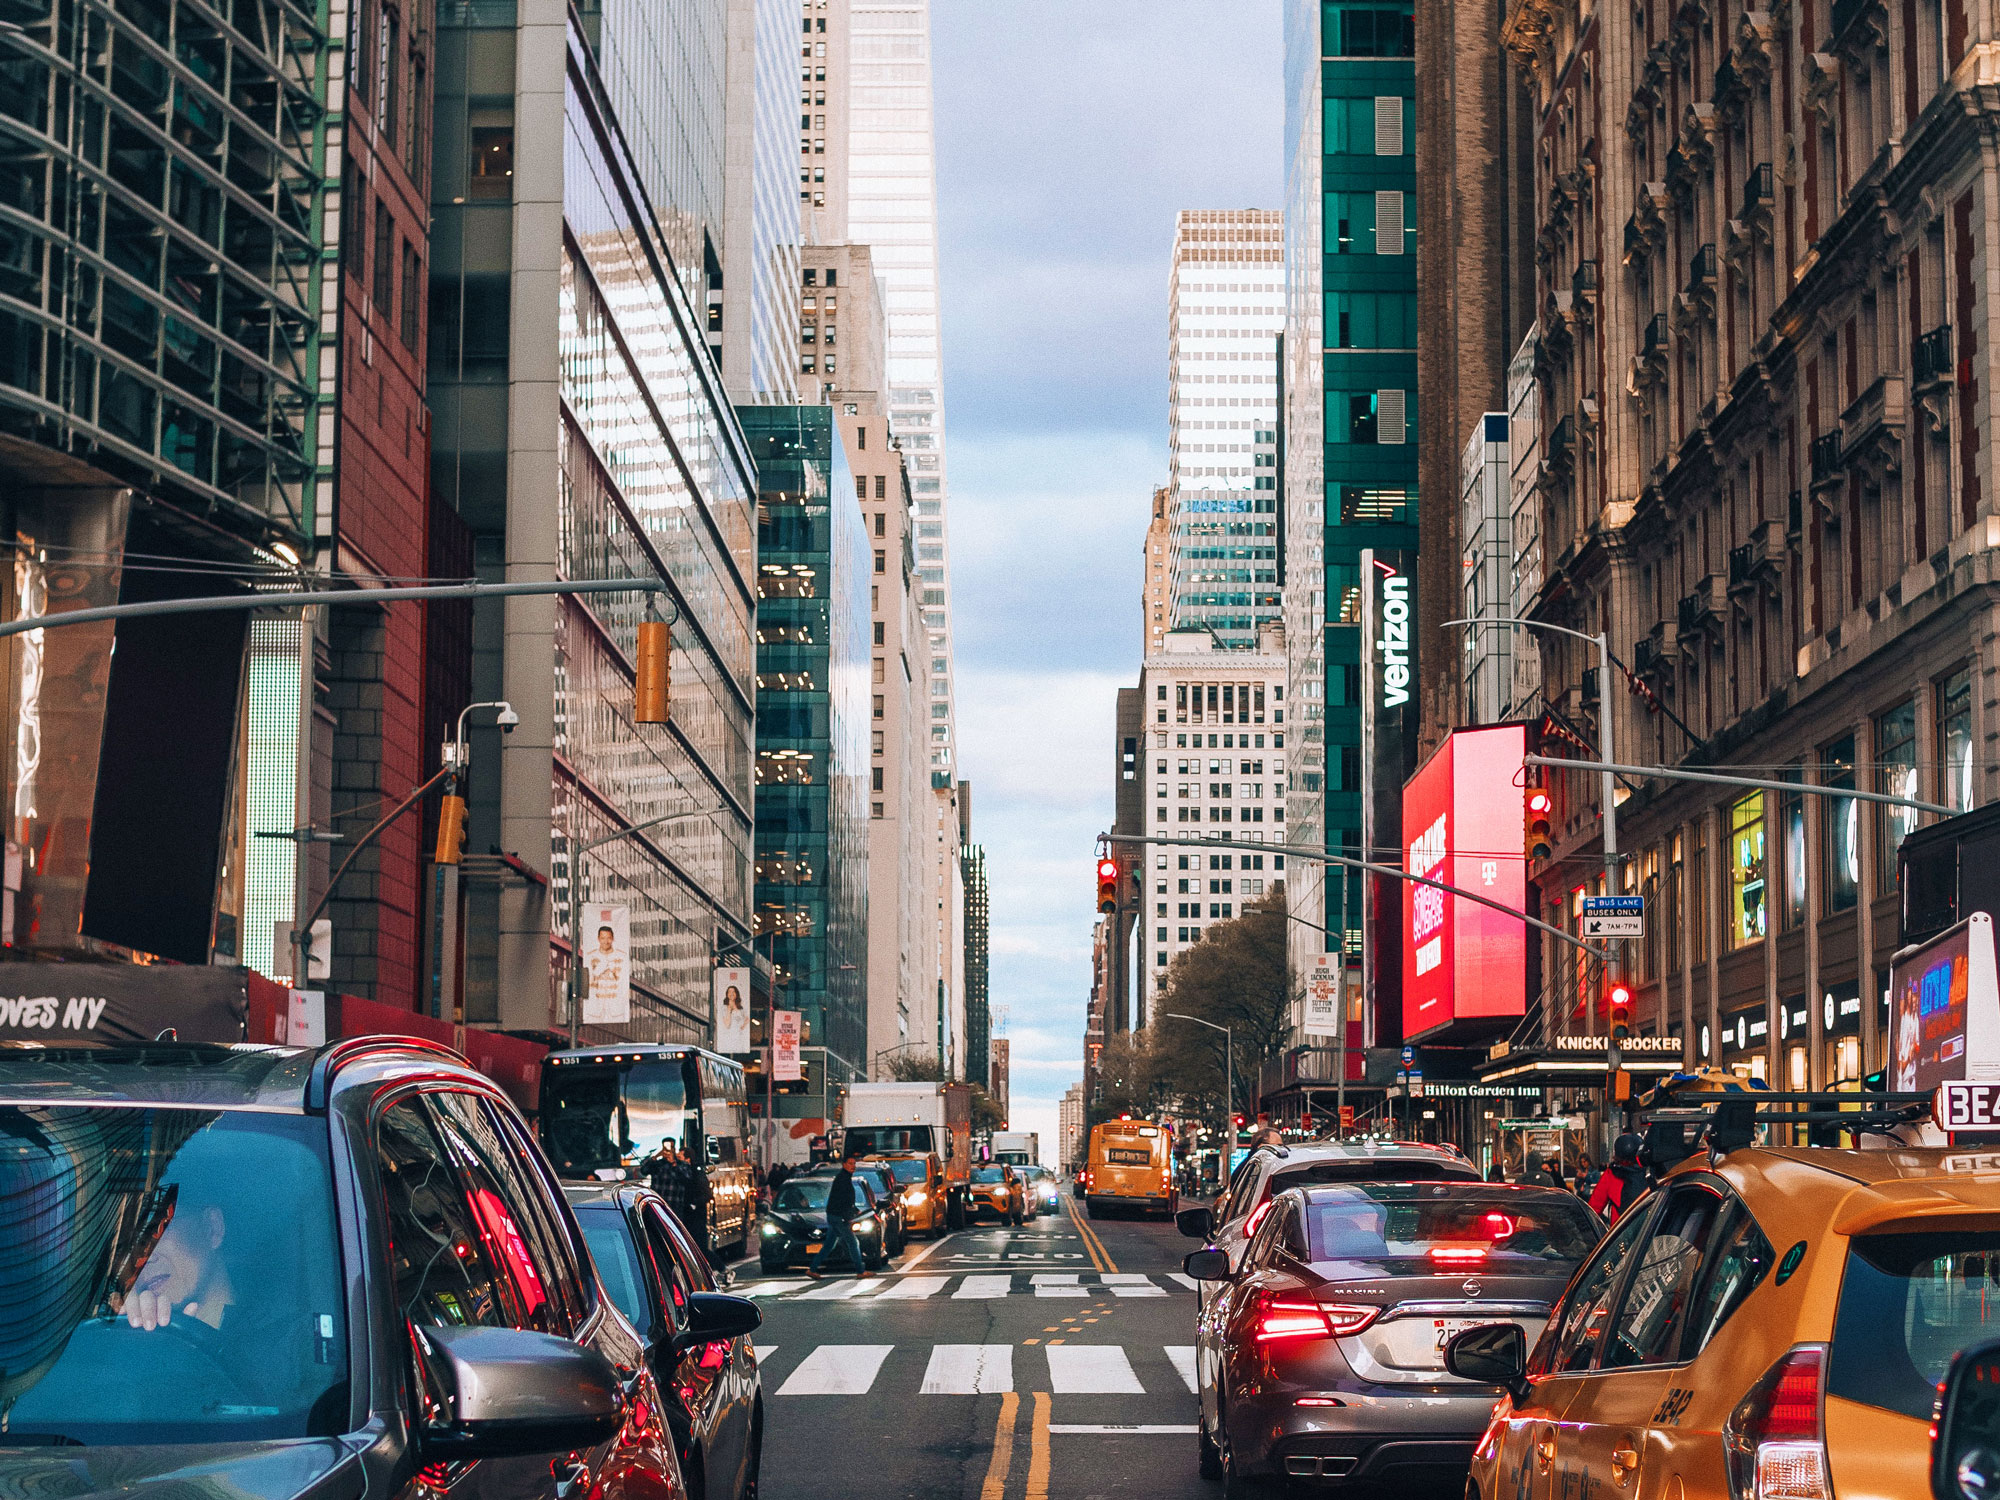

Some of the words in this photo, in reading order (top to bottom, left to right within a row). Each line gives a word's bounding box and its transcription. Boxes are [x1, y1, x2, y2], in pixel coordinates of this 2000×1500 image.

[1376, 577, 1410, 708] verizon
[1616, 908, 1638, 916] ONLY
[62, 997, 107, 1031] NY
[562, 1057, 580, 1065] 1351
[658, 1052, 676, 1060] 1351
[1424, 1085, 1467, 1097] Hilton
[1468, 1085, 1515, 1097] Garden
[1518, 1086, 1541, 1097] Inn
[938, 1252, 1084, 1260] ONLY
[1653, 1388, 1694, 1426] 3E42
